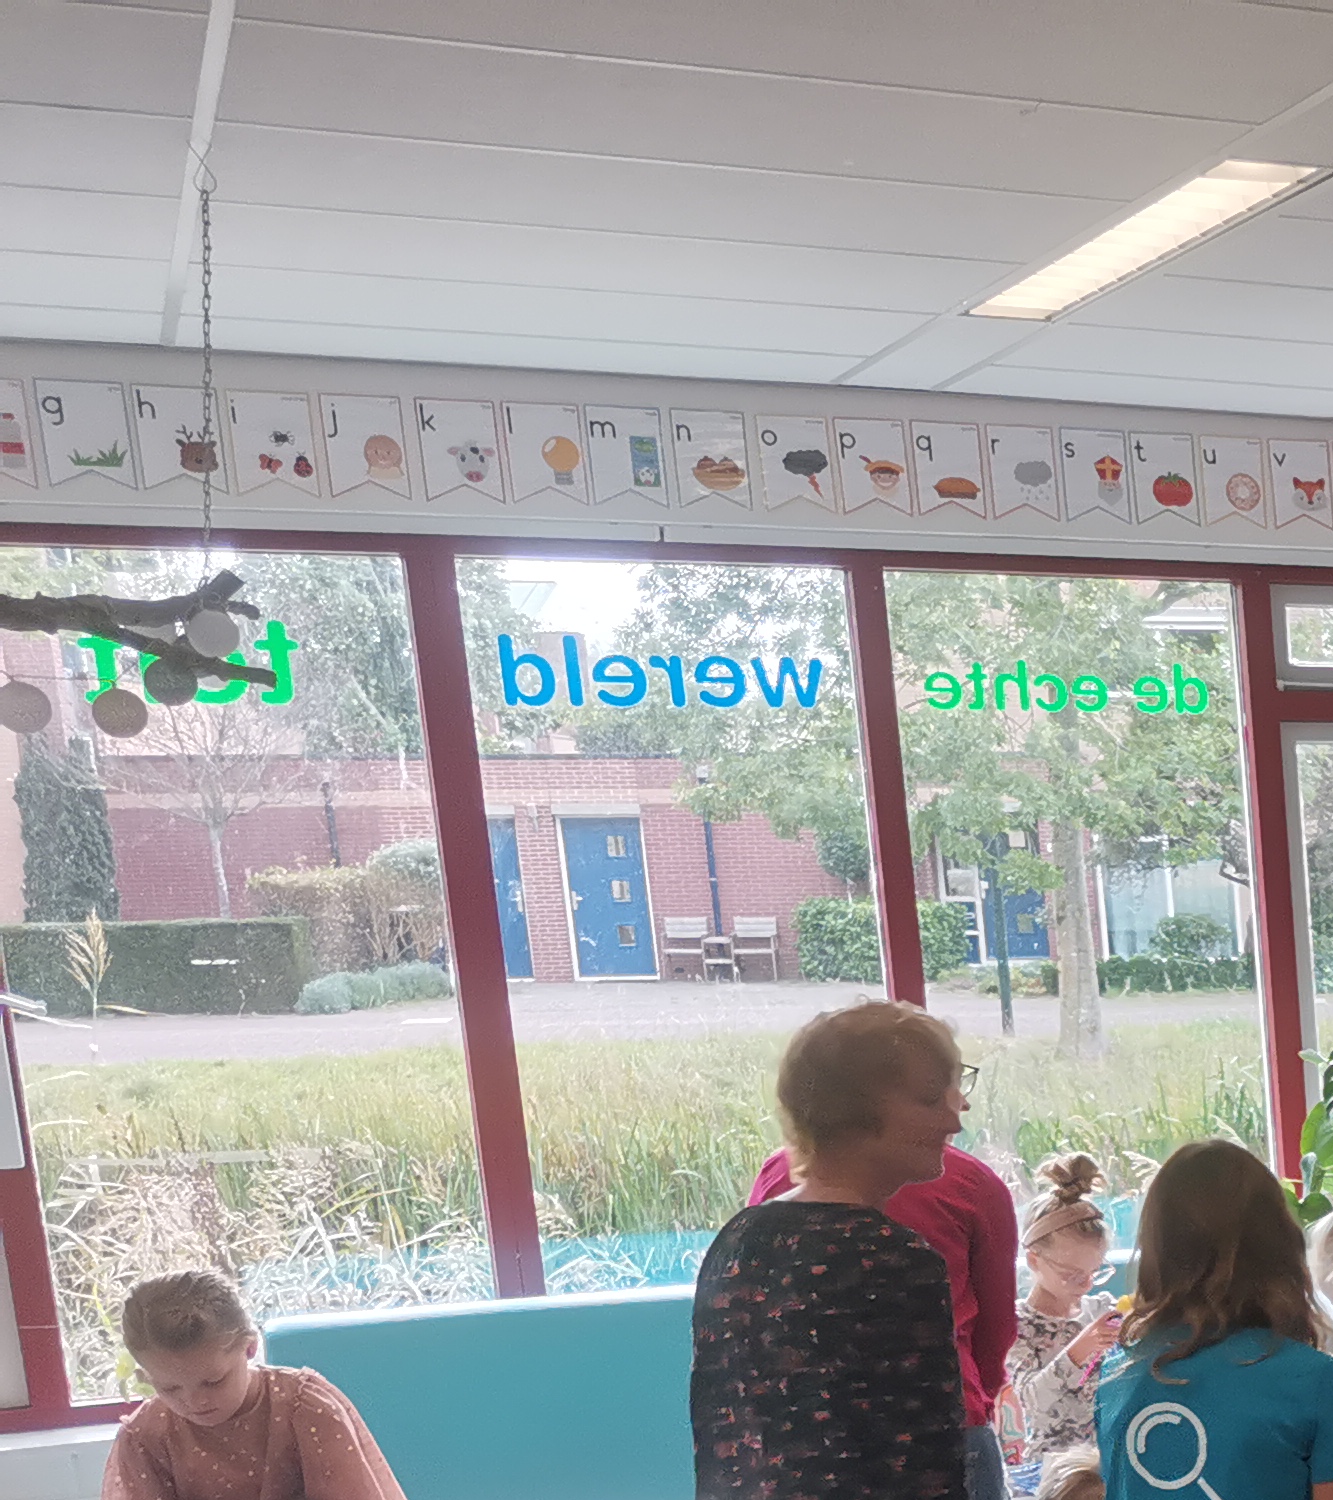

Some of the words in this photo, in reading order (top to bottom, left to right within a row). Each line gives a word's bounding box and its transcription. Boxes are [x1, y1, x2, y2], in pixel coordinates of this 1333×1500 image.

[41, 395, 64, 425] g
[137, 390, 157, 418] h
[328, 402, 339, 438] j
[420, 402, 436, 432] k
[590, 416, 617, 438] m
[676, 421, 692, 442] n
[761, 430, 777, 446] o
[838, 431, 856, 458] p
[916, 434, 933, 461] q
[990, 436, 1000, 455] r
[1064, 439, 1076, 459] s
[1134, 439, 1147, 463] t
[1203, 446, 1217, 465] u
[1273, 451, 1287, 467] v
